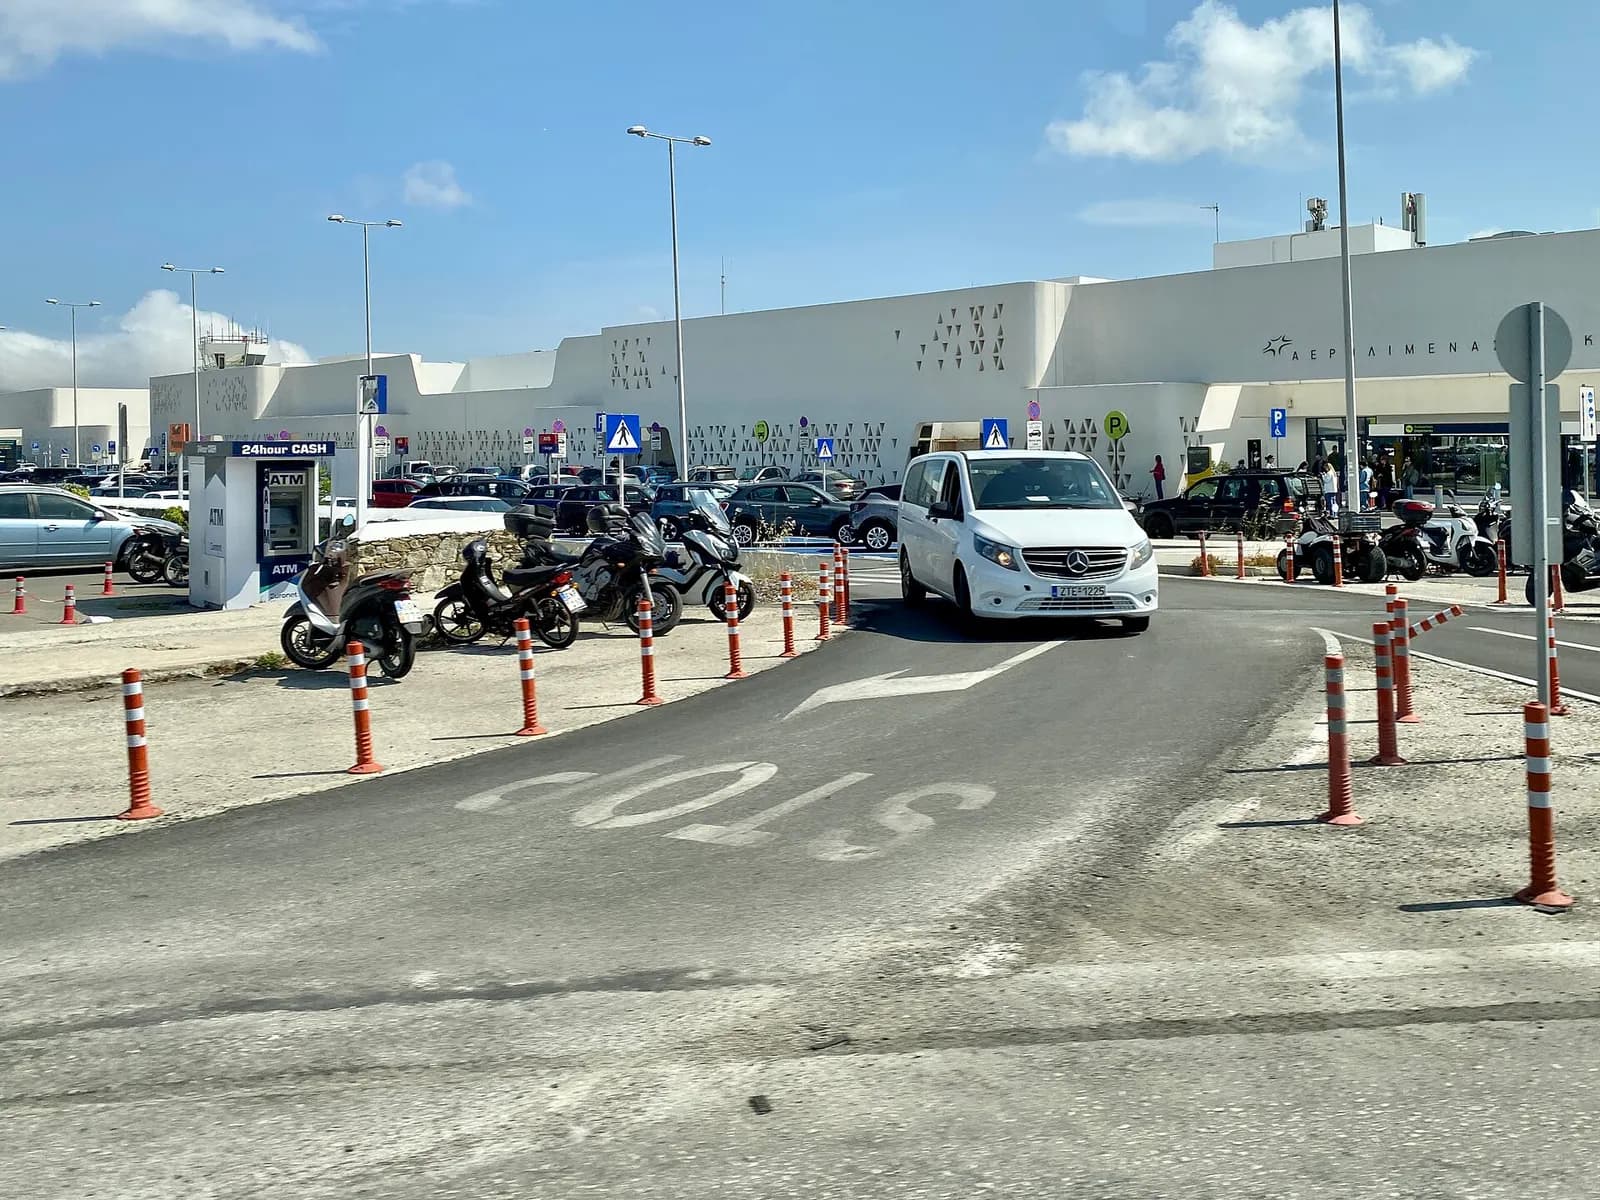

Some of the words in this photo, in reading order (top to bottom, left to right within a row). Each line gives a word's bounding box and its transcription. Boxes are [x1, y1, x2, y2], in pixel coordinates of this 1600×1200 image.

[1292, 341, 1497, 361] ΑΕΡΛΙΜΕΝΑ
[1274, 410, 1283, 424] P
[241, 444, 288, 455] 24hour
[292, 443, 327, 454] CASH
[270, 474, 304, 485] ATM
[209, 508, 224, 526] ATM
[272, 563, 298, 575] ATM
[453, 754, 997, 863] STOP
